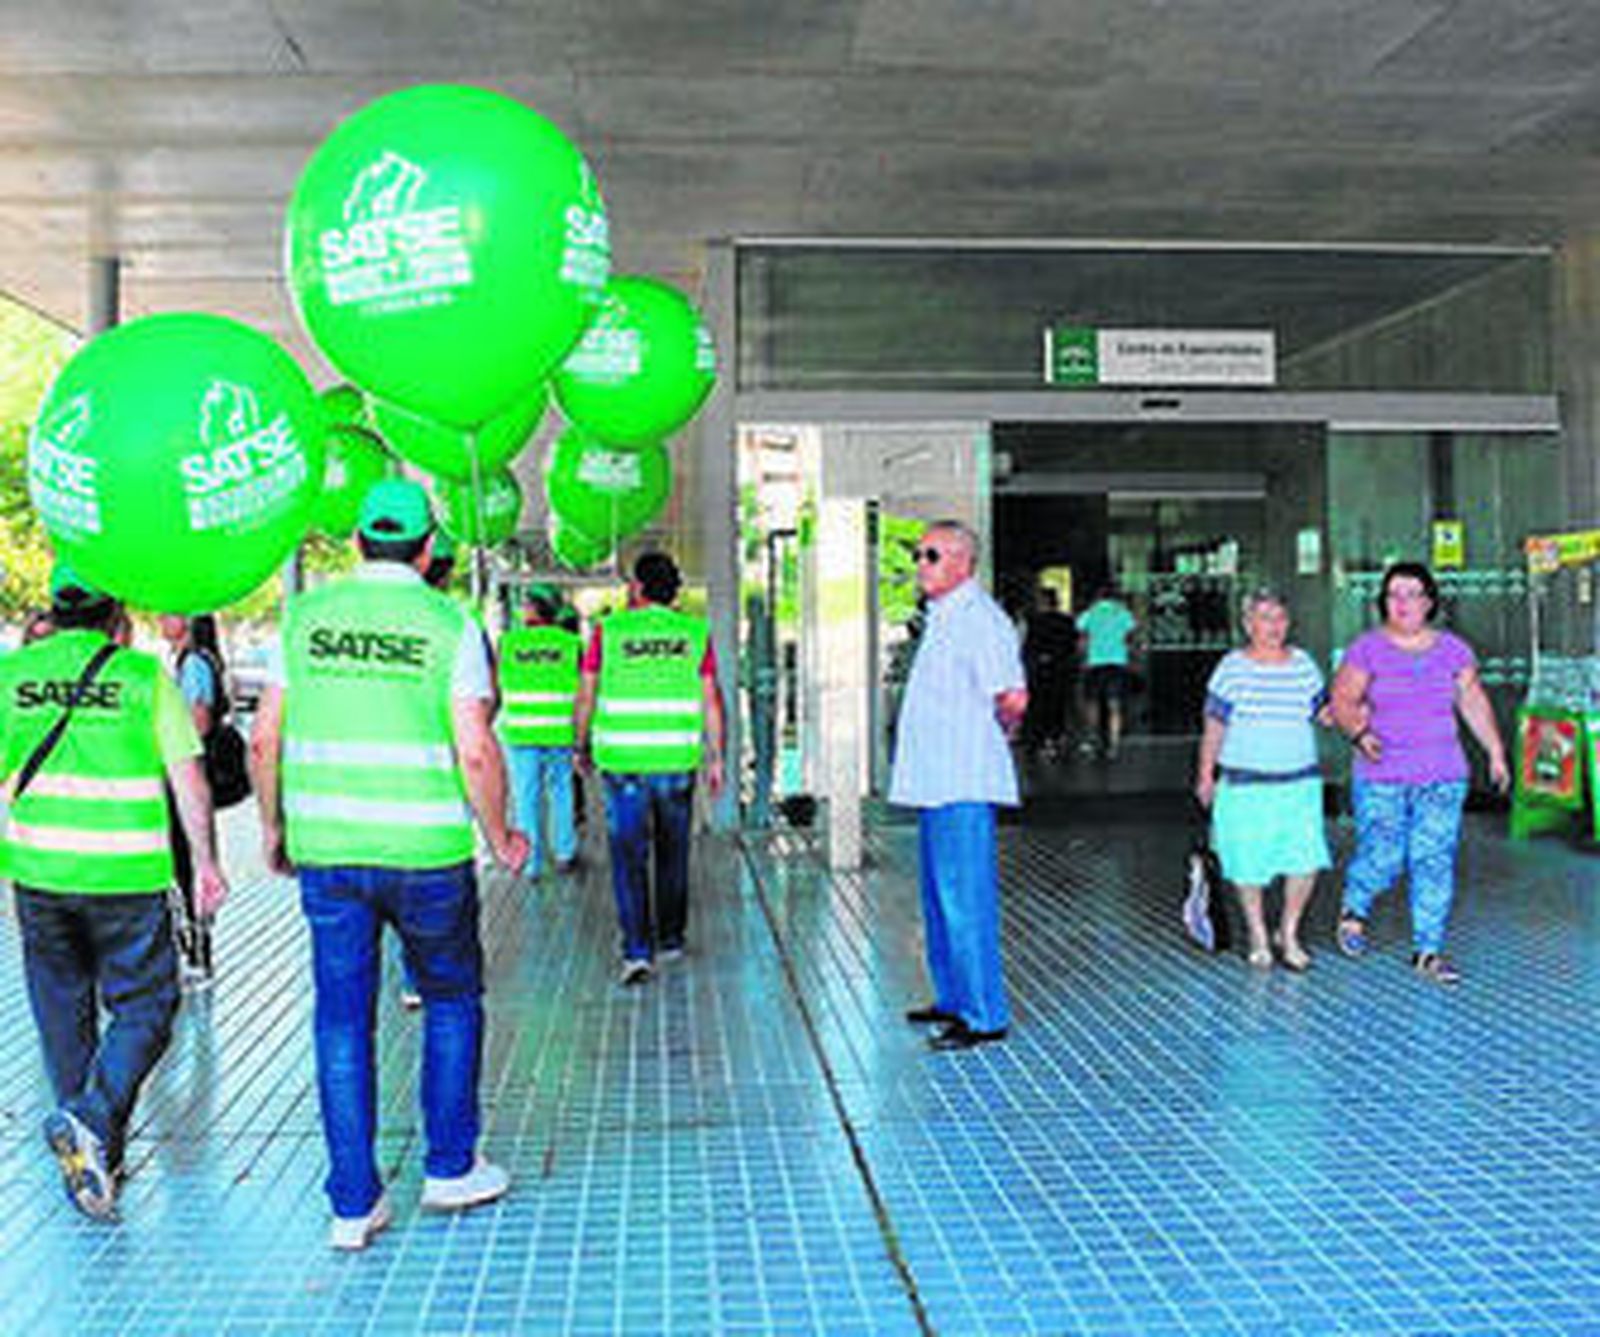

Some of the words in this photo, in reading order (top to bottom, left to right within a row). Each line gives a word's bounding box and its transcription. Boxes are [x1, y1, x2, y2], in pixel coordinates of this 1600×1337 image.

[321, 207, 460, 268] SATSE
[180, 413, 298, 493] SATSE
[309, 628, 428, 667] SATSE
